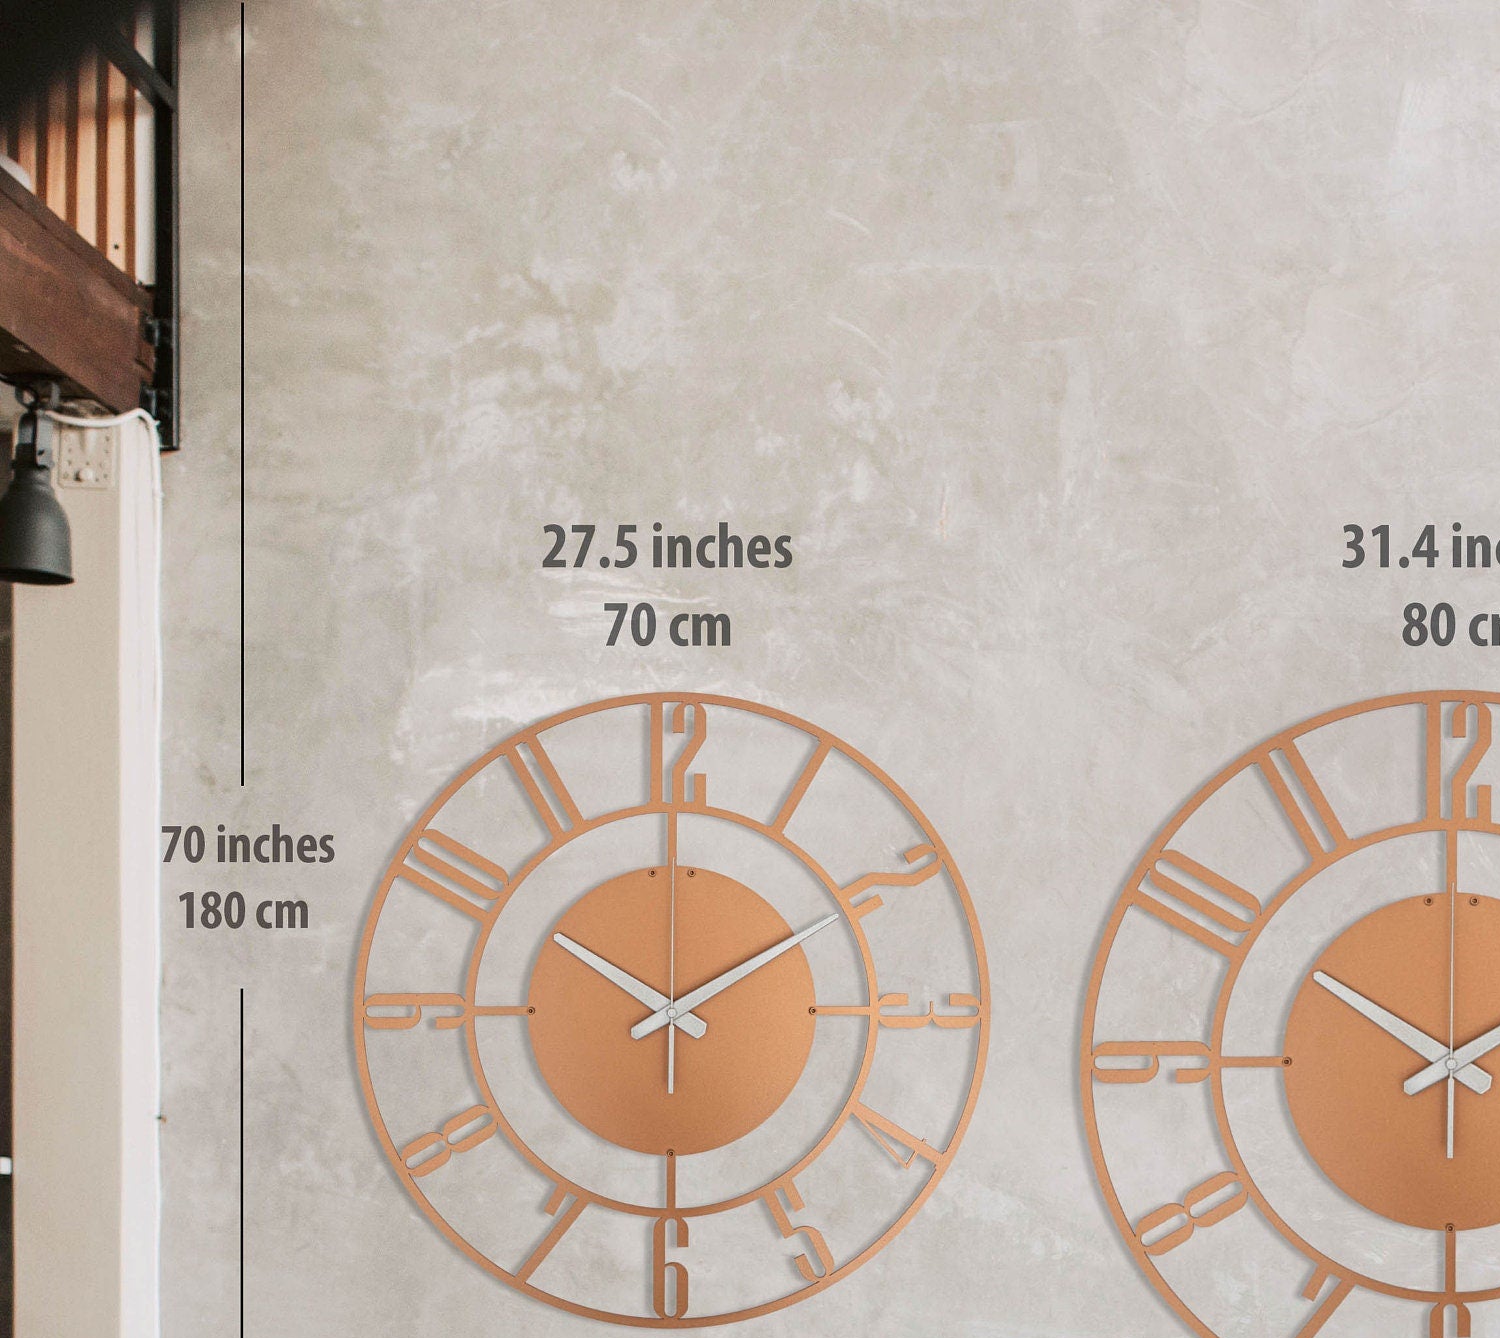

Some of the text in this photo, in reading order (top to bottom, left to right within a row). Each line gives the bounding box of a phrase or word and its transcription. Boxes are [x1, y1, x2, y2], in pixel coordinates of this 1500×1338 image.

[503, 731, 587, 838] 11
[649, 701, 708, 806] 12
[1255, 735, 1353, 860] 11
[1425, 699, 1493, 822] 12
[397, 829, 510, 923] 10
[840, 843, 942, 917] 2
[1131, 849, 1262, 959] 10
[364, 993, 467, 1030] 9
[878, 993, 982, 1029] 3
[1092, 1040, 1213, 1083] 9
[401, 1106, 499, 1177] 8
[851, 1099, 943, 1170] 4
[514, 1178, 591, 1285] 7
[763, 1176, 835, 1282] 5
[1135, 1172, 1250, 1256] 8
[653, 1216, 689, 1320] 6
